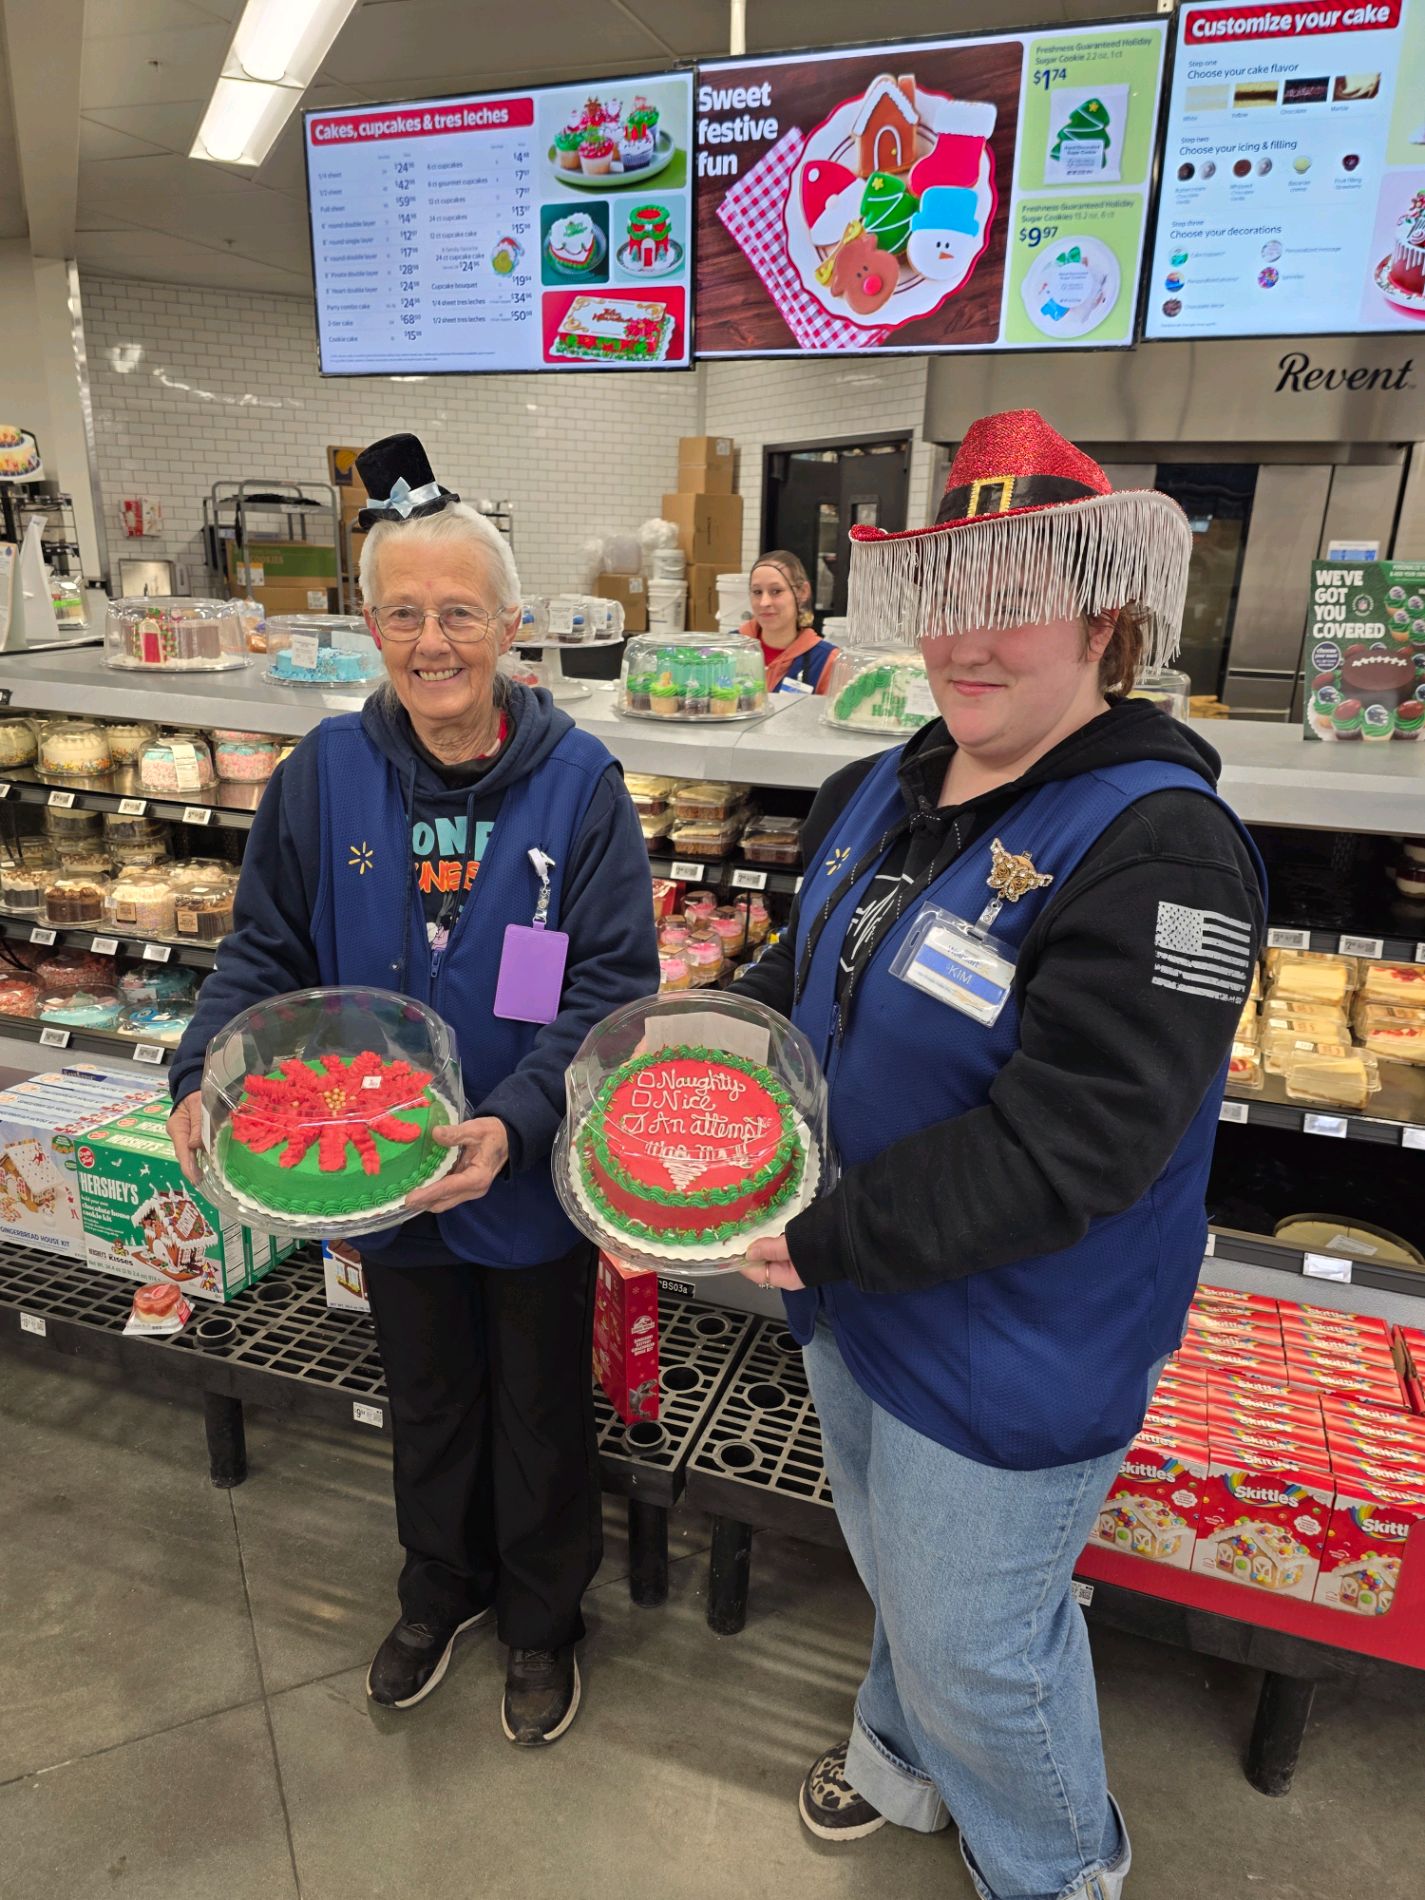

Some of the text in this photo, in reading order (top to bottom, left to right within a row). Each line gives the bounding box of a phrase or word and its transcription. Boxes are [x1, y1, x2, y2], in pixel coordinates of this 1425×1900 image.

[1192, 4, 1391, 38] Customize your cake
[1036, 37, 1152, 54] Freshness Guaranteed Holiday
[1035, 57, 1057, 66] Sugar
[1059, 54, 1085, 63] Cookie
[1187, 63, 1300, 80] Choose your cake flavor
[699, 81, 771, 112] Sweet
[315, 108, 508, 140] Cakes, cupcakes & tres leches
[698, 114, 778, 144] festive
[1179, 140, 1298, 156] Choose your icing & filling
[698, 150, 738, 177] fun
[1022, 200, 1135, 213] Freshness Guaranteed Holiday
[1170, 226, 1282, 239] Choose your decorations
[1274, 352, 1414, 392] Revent
[1314, 587, 1348, 603] GOT
[1314, 605, 1346, 621] YOU
[1312, 622, 1386, 639] COVERED
[656, 1069, 746, 1101] Naughty
[653, 1090, 717, 1111] Nice
[648, 1111, 766, 1150] An attempt
[78, 1171, 139, 1205] HERSHEY'S
[1238, 1379, 1287, 1395] Skittles
[1239, 1398, 1290, 1413] Skittles
[1239, 1415, 1292, 1432] Skittles
[1354, 1407, 1408, 1424] Skittles
[1358, 1425, 1413, 1442] Skittles
[1242, 1435, 1296, 1451] Skittles
[1362, 1444, 1419, 1463] Skittles
[1119, 1461, 1176, 1483] Skittles
[1234, 1485, 1299, 1508] Skittles
[1362, 1518, 1409, 1537] Skittl
